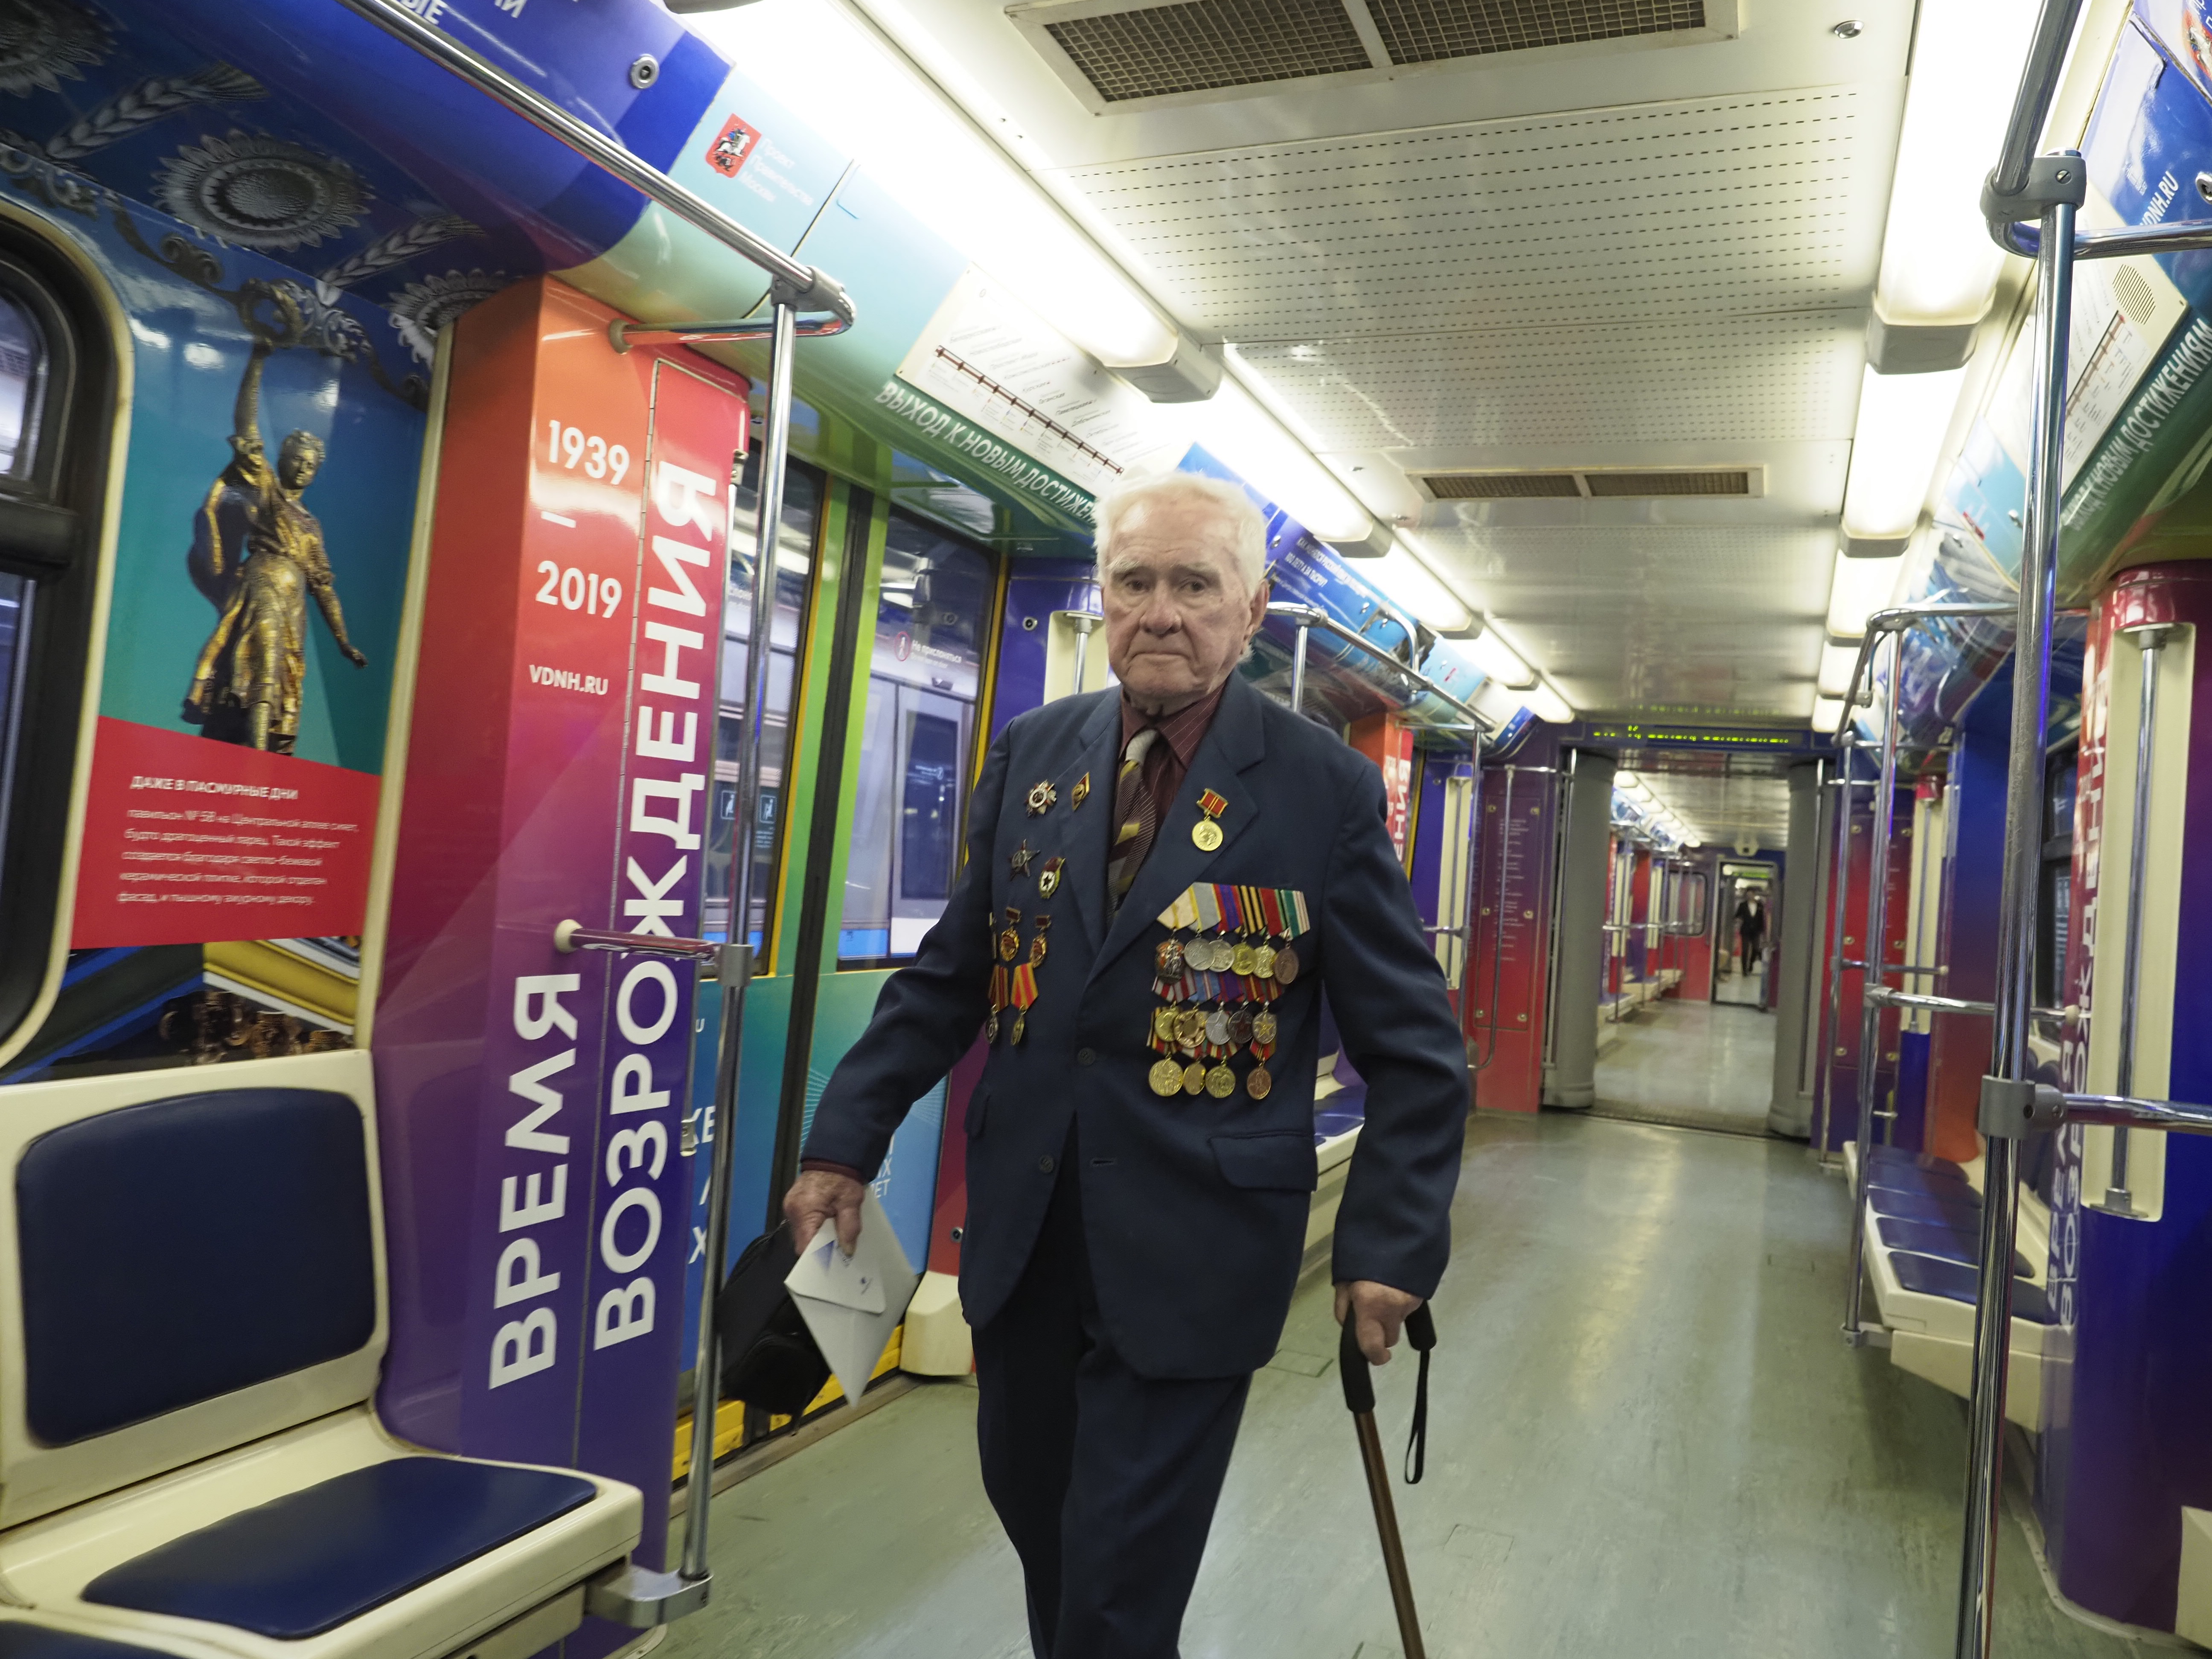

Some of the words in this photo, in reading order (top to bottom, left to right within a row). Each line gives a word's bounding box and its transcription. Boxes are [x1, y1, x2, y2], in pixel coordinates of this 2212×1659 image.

[2140, 171, 2178, 225] DNH.RU
[2120, 318, 2212, 452] ДОСТИЖЕНИЯМ
[549, 419, 630, 485] 1939
[875, 382, 951, 438] ВЫХОД
[944, 422, 967, 444] К
[958, 431, 1027, 479] НОВЫМ
[536, 560, 622, 618] 2019
[529, 664, 609, 695] VDNH.RU
[130, 776, 175, 789] ДАЖЕ
[174, 780, 186, 790] В
[186, 780, 270, 798] ПАСМУРНЫЕ
[268, 788, 298, 800] ДНИ
[489, 973, 580, 1390] ВРЕМЯ
[594, 460, 717, 1350] ВОЗРОЖДЕНИЯ
